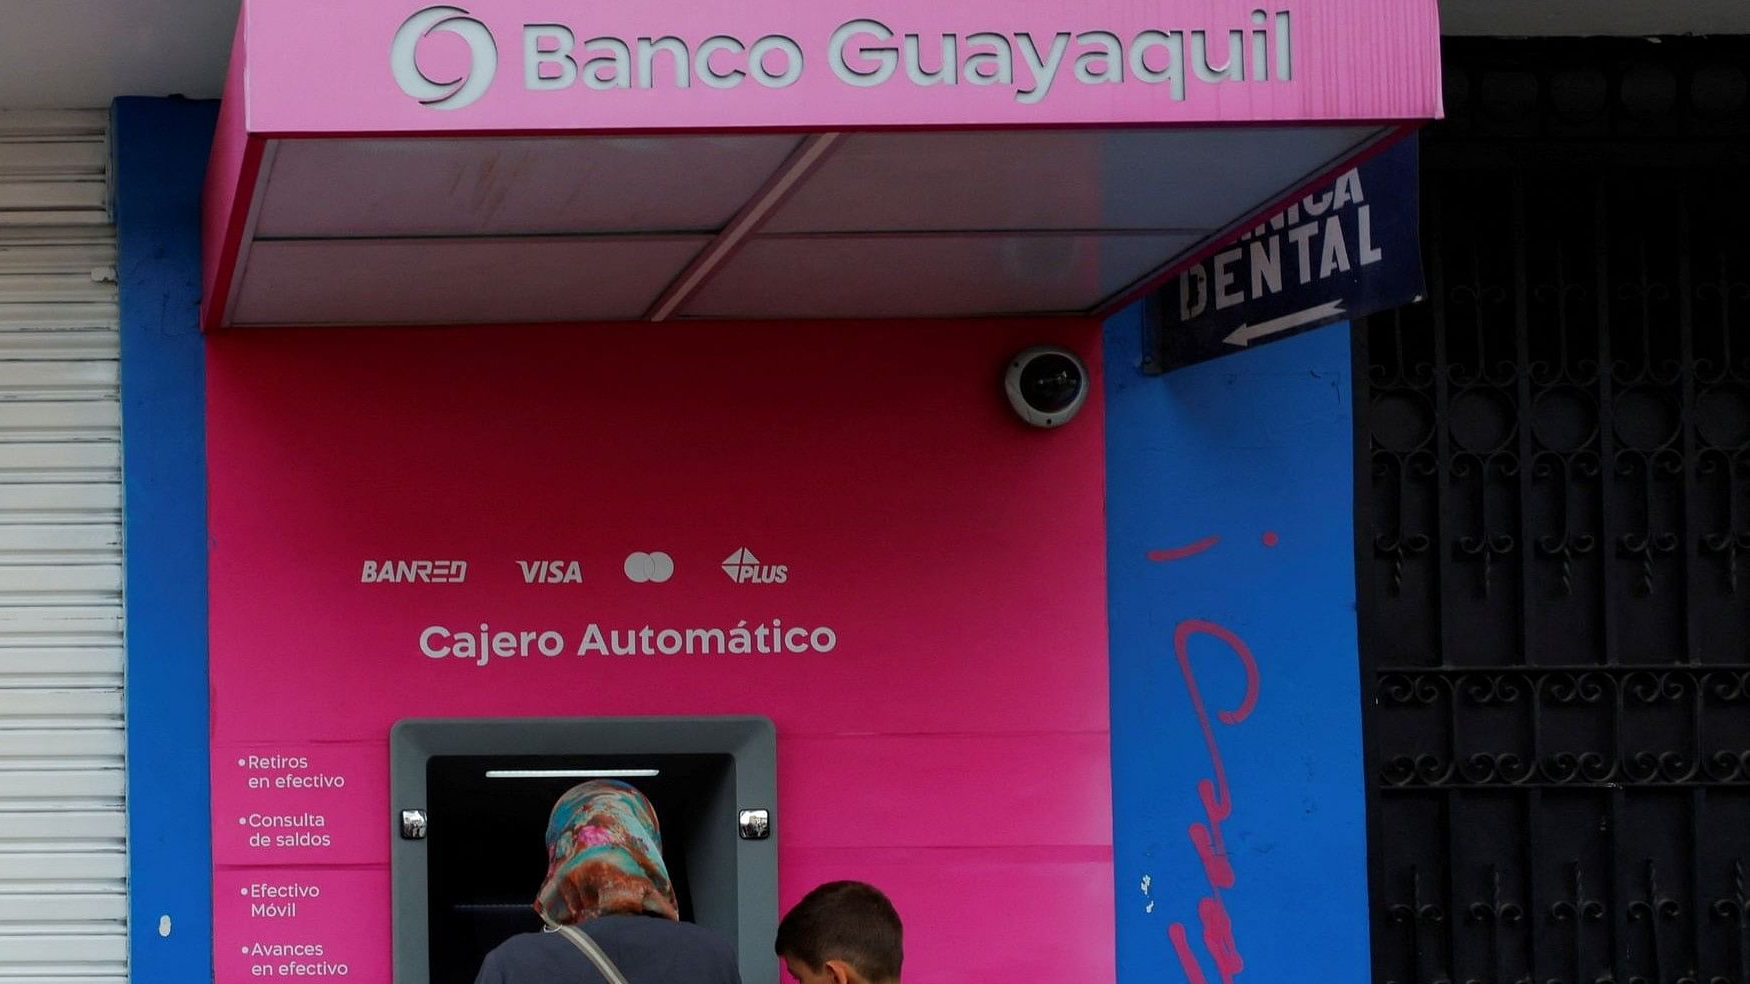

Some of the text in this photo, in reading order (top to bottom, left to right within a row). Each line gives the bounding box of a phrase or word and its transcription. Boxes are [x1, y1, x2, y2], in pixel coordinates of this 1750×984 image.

[522, 9, 1294, 106] Banco Guayaquil
[1179, 204, 1382, 321] DENTAL
[361, 560, 788, 584] BANRED VISA PLUS
[418, 618, 837, 667] Cajero Automático
[248, 754, 309, 769] Retiros
[248, 773, 345, 789] en efectivo
[249, 812, 325, 828] Consulta
[249, 832, 331, 848] de saldos
[251, 883, 320, 898] Efectivo
[251, 903, 297, 918] Móvil
[251, 942, 324, 957] Avances
[251, 961, 349, 976] en efectivo
